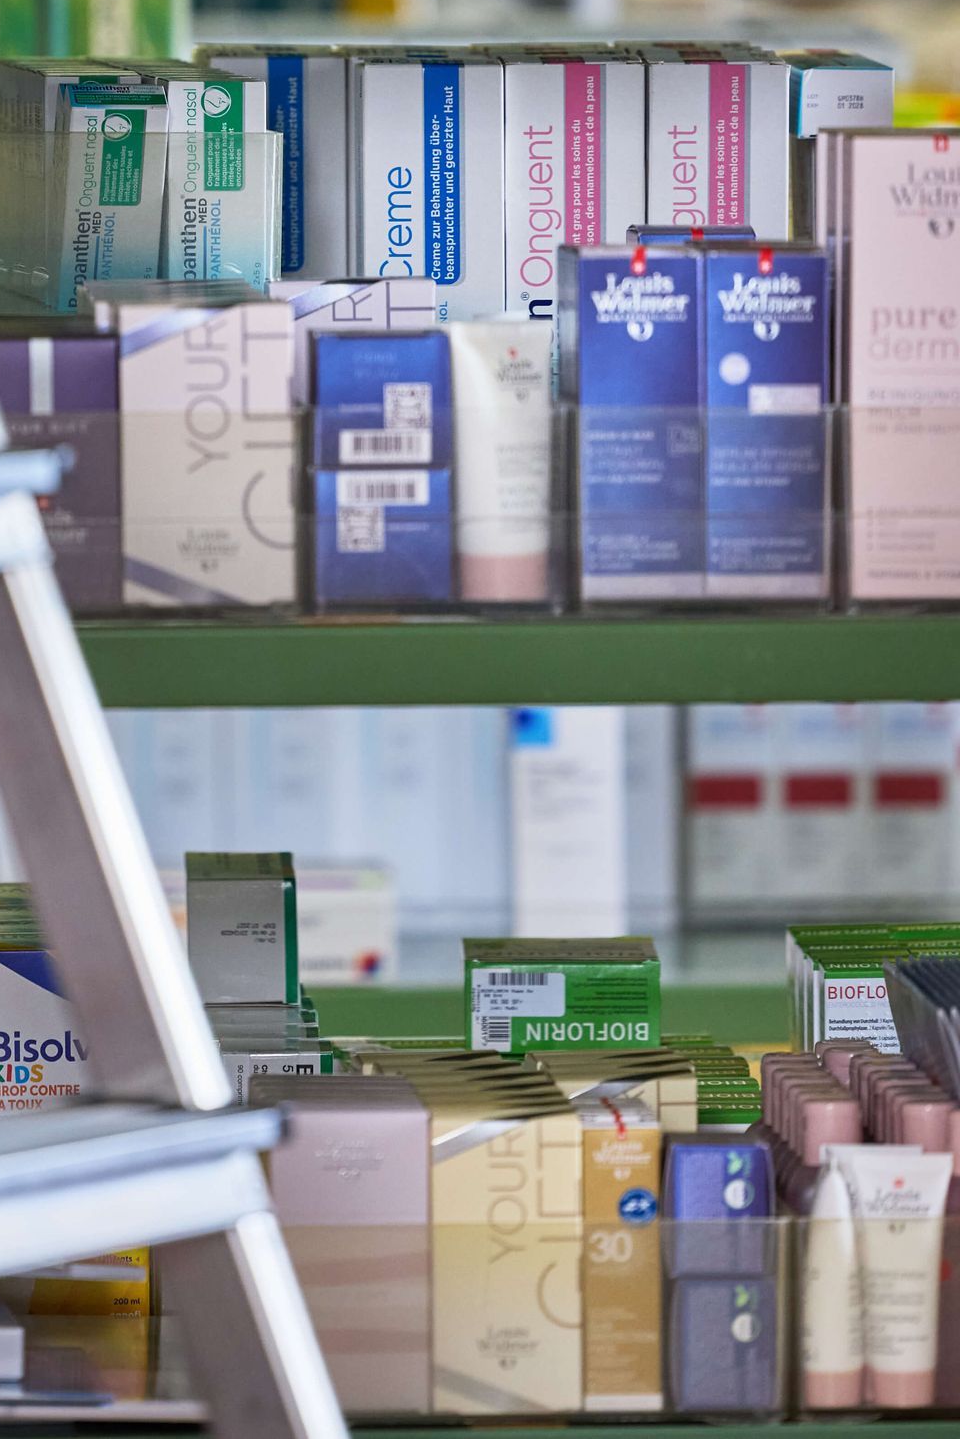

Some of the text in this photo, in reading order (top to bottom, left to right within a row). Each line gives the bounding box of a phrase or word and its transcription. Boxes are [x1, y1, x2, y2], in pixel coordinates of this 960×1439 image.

[182, 88, 200, 193] Onguent nasal
[585, 76, 596, 219] des mamelons et de la peau
[444, 86, 455, 279] beanspruchter und gereizter Haut
[571, 119, 582, 231] gras pour les soins du
[430, 114, 442, 279] Creme zur Behandlung über-
[520, 125, 561, 287] Onguent
[68, 115, 98, 308] Bpanthen Onguent nasal
[198, 197, 207, 223] MED
[379, 165, 413, 276] Creme
[92, 211, 102, 234] MED
[606, 272, 675, 294] Louis
[733, 272, 802, 294] Louis
[591, 291, 690, 313] Widmer
[717, 290, 816, 313] Widmer
[828, 986, 886, 1000] BIOFLO
[526, 1022, 650, 1042] BIOFLORIN
[29, 1084, 80, 1096] CONTRE
[7, 1099, 43, 1111] TOUX
[589, 1231, 633, 1263] 30
[113, 1297, 129, 1306] 200
